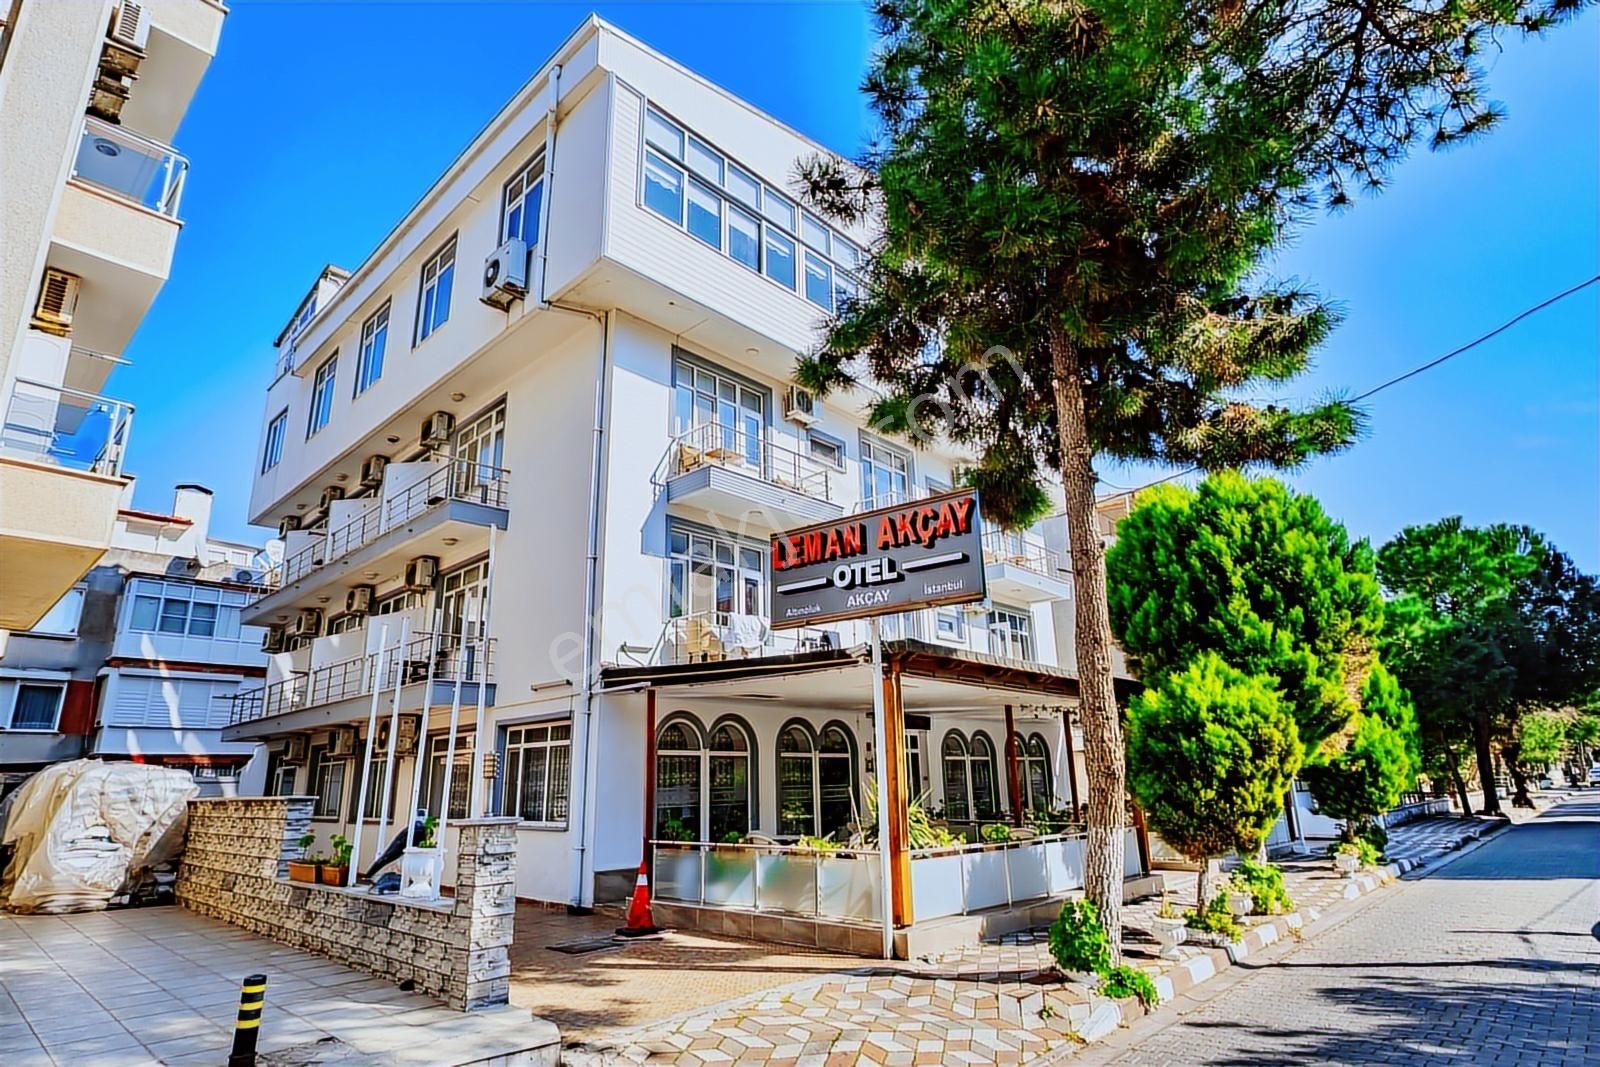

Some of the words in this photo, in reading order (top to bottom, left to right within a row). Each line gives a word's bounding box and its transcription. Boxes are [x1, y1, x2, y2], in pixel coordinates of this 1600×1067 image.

[773, 523, 865, 570] LEMAN
[878, 498, 975, 547] AKÇAY
[833, 557, 899, 588] OTEL
[847, 590, 890, 607] AKÇAY
